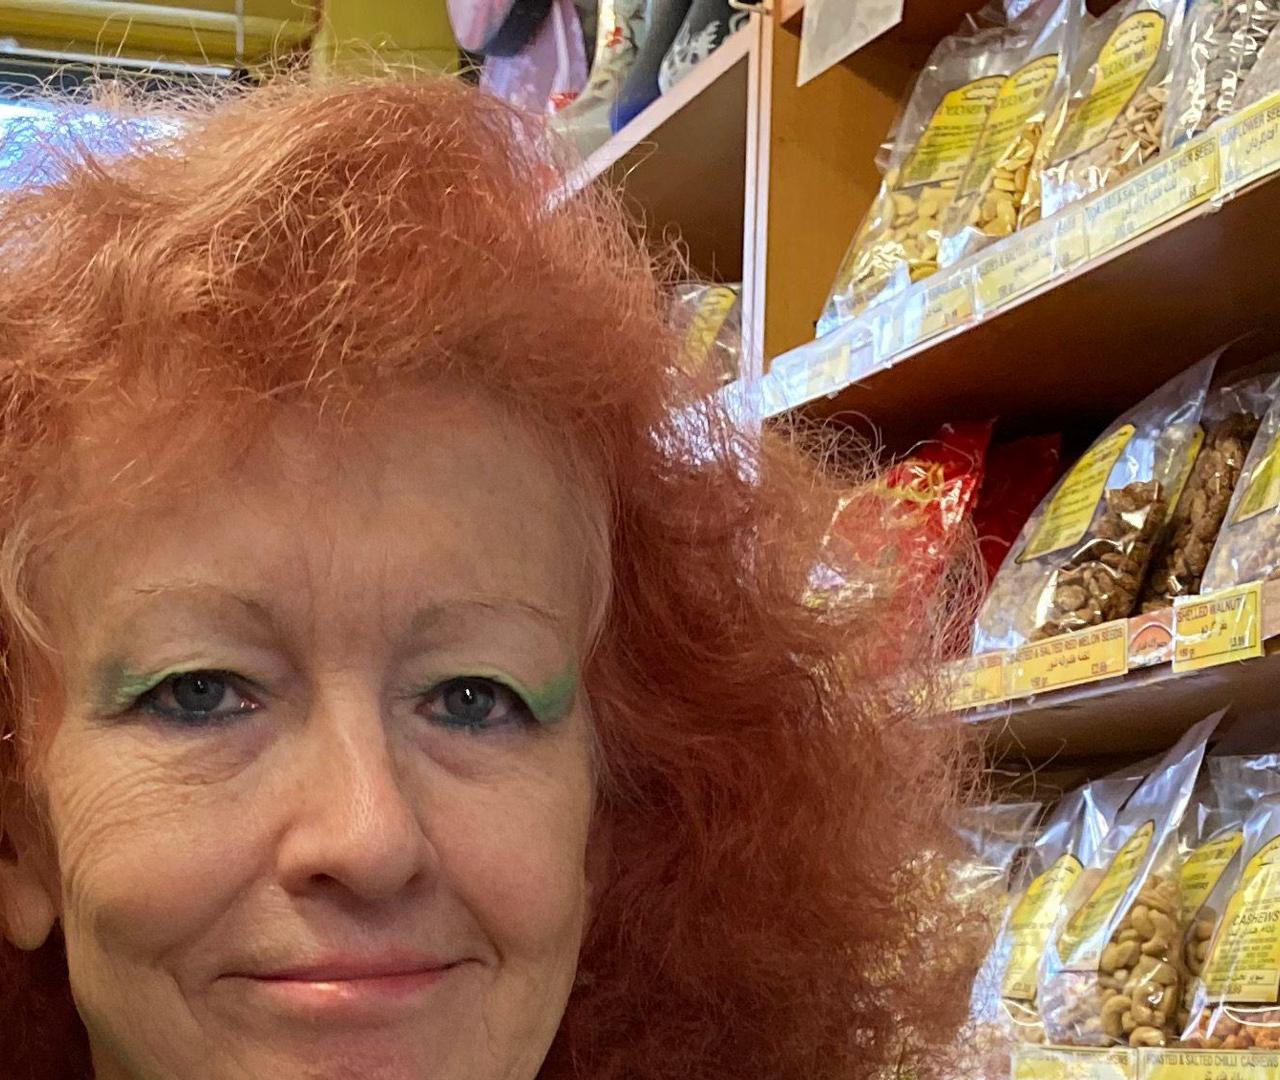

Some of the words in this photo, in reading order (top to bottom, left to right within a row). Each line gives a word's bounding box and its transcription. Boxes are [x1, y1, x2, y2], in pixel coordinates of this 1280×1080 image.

[1232, 911, 1280, 927] CASHEWS
[1185, 1054, 1214, 1067] SALTED
[1214, 1055, 1238, 1068] CHILLI
[1240, 1055, 1280, 1068] CASHEWS
